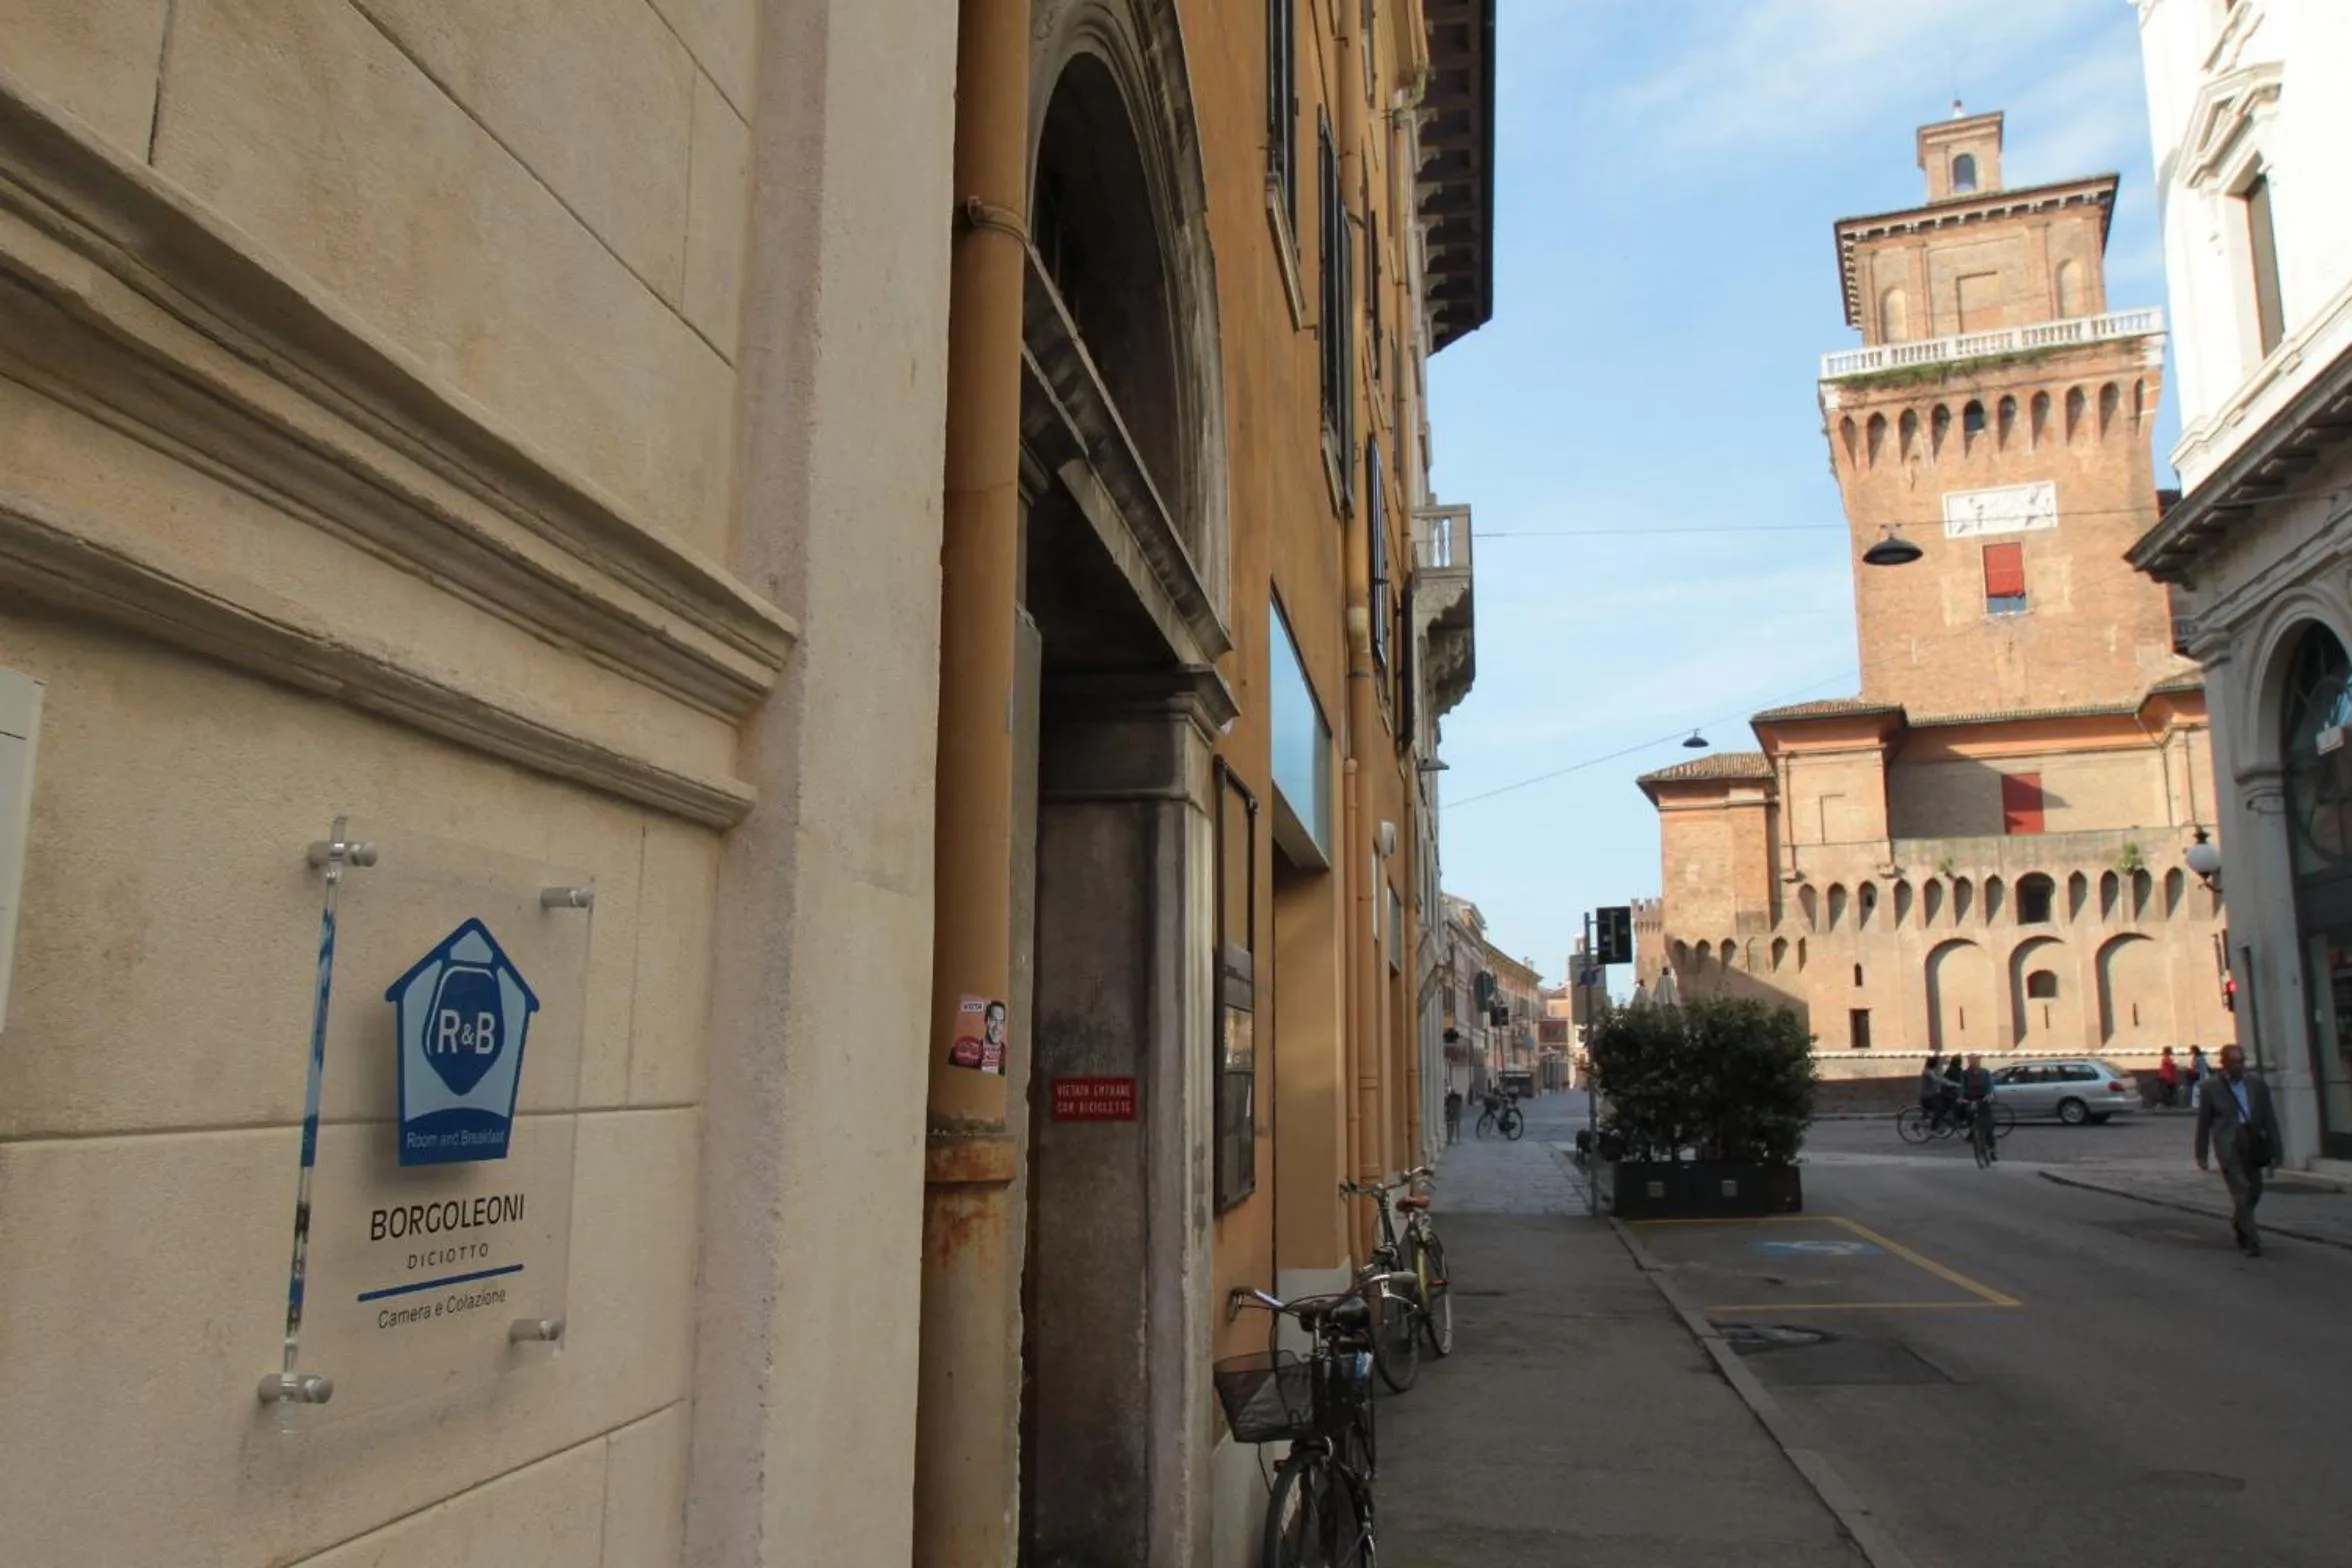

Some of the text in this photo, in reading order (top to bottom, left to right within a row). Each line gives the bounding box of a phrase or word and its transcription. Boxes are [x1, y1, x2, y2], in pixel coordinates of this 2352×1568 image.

[437, 1009, 496, 1054] R&B
[407, 1129, 505, 1149] Room and Breakfast
[370, 1193, 525, 1241] BORGOLEONI
[407, 1243, 489, 1269] DICIOTTO
[378, 1289, 506, 1329] Camera e Colazione
